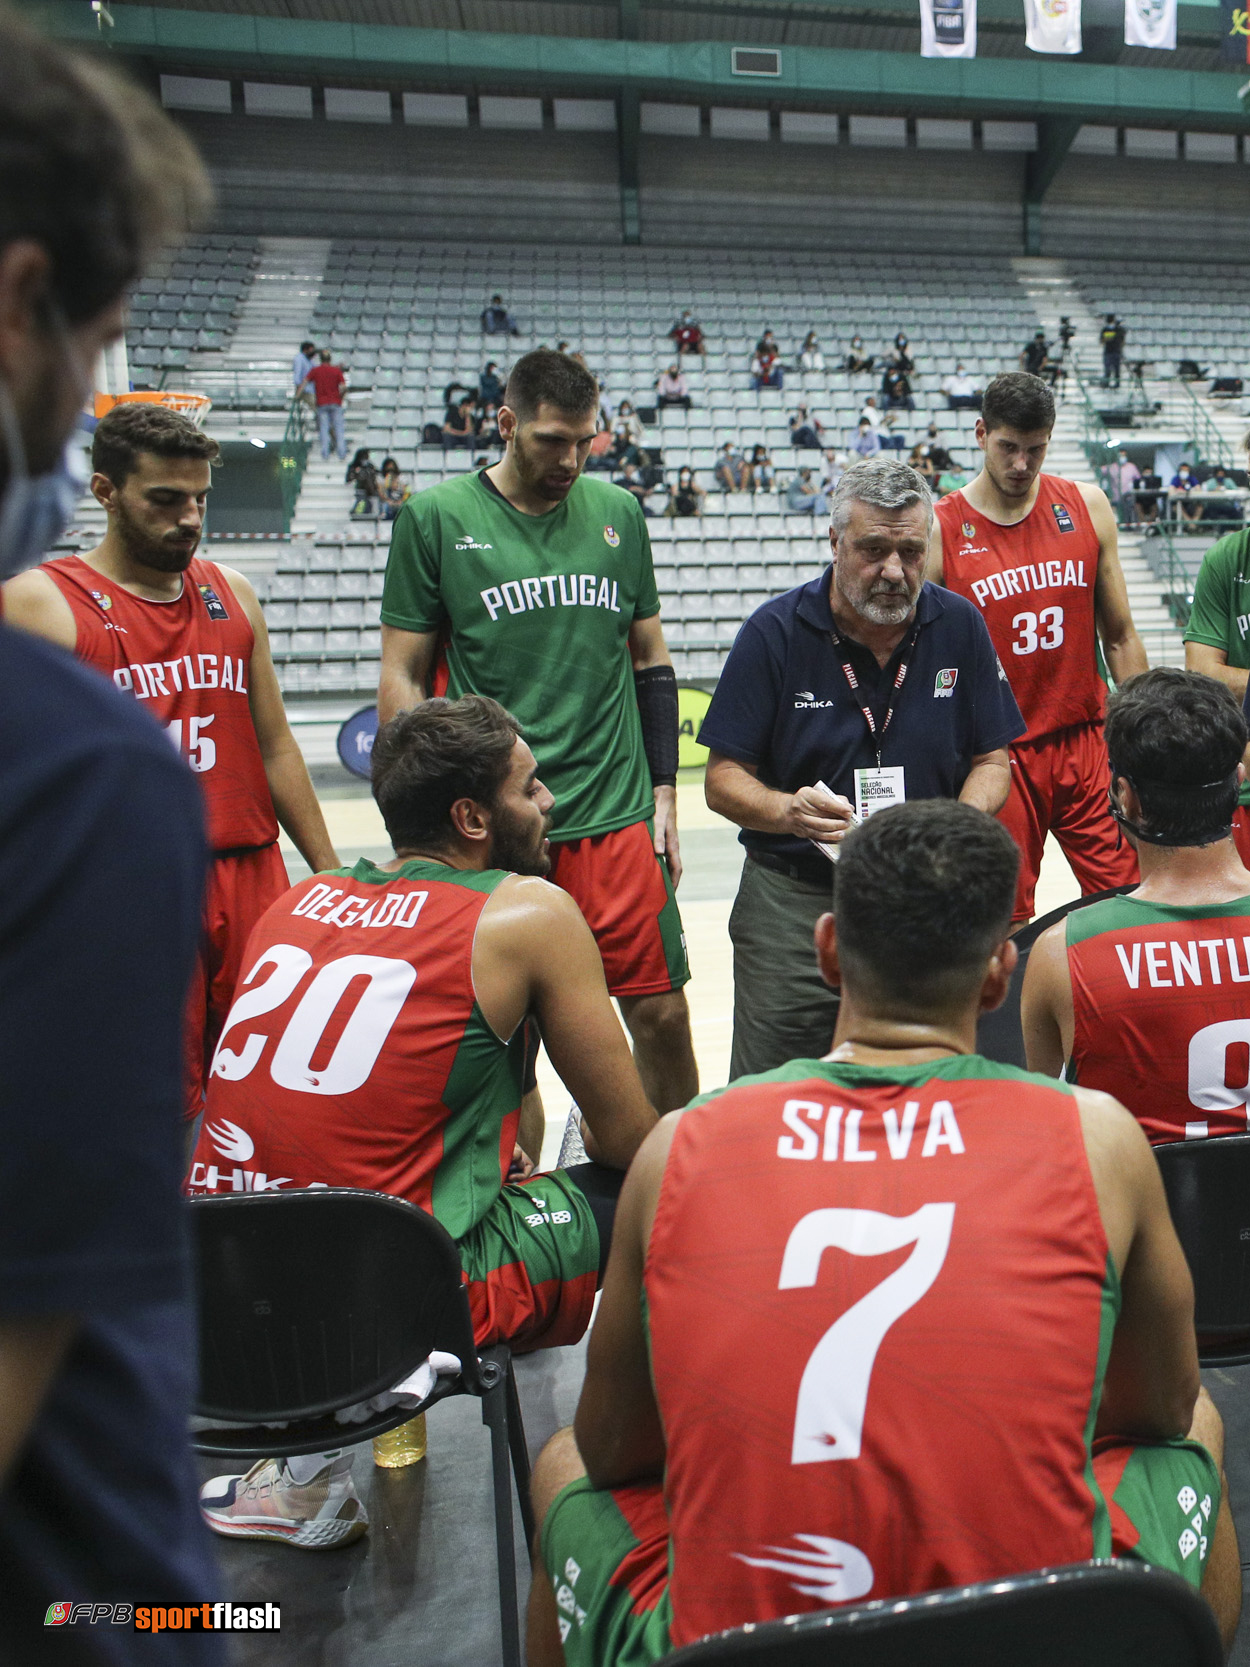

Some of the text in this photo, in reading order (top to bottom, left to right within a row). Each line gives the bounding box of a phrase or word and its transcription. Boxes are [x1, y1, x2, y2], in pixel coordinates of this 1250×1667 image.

[480, 574, 621, 622] PORTUGAL
[970, 559, 1088, 608] PORTUGAL
[1012, 605, 1065, 656] 33
[794, 699, 835, 709] DHIKA
[861, 787, 894, 796] NACIONAL
[208, 943, 418, 1096] 20
[776, 1100, 966, 1162] SILVA
[777, 1202, 956, 1465] 7
